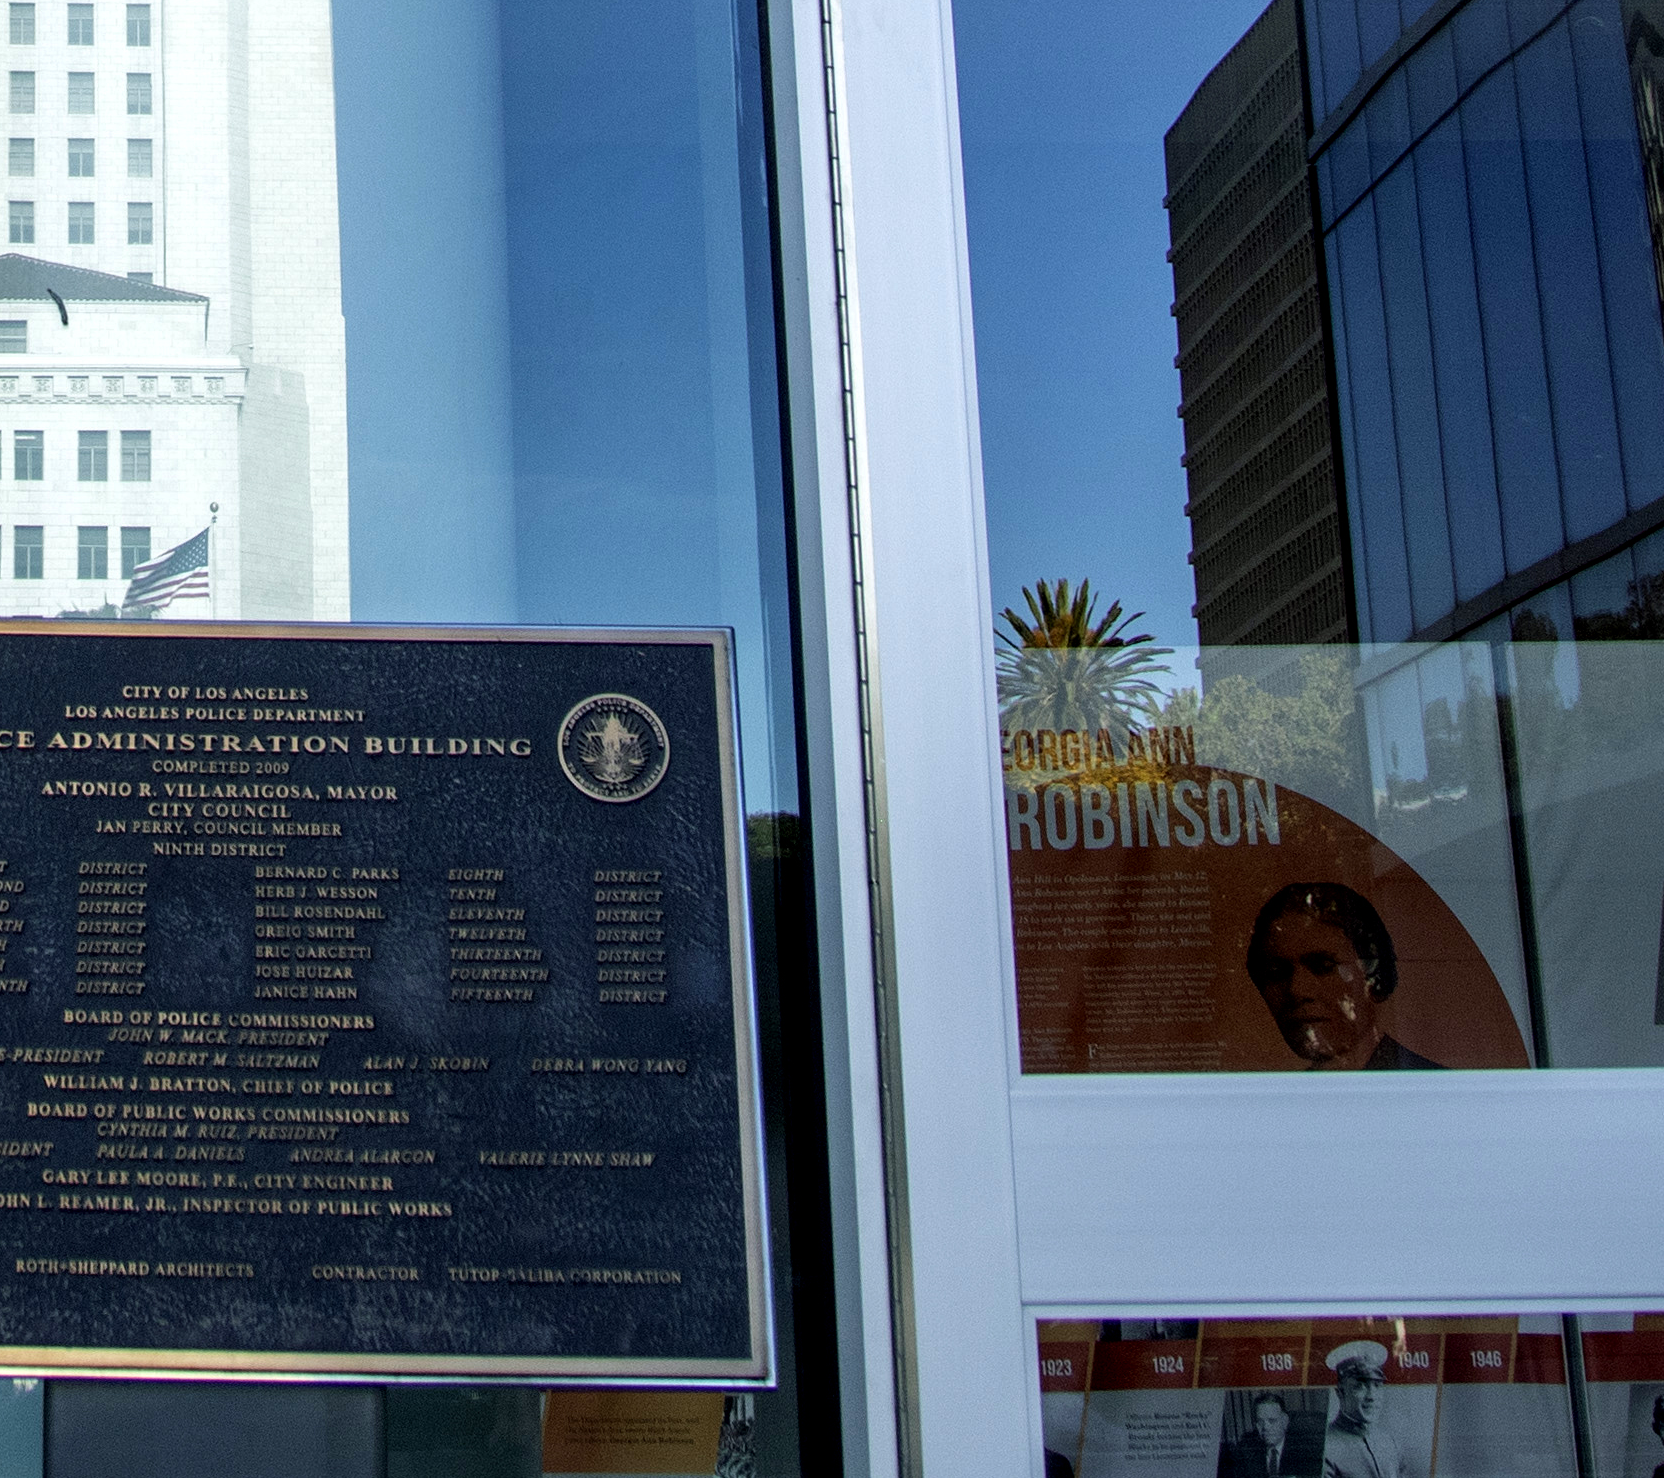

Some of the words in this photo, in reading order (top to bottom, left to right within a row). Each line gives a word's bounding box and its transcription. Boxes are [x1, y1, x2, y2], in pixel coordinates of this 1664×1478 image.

[122, 685, 163, 699] CITY
[168, 686, 191, 700] OF
[195, 687, 227, 700] LOS
[232, 687, 309, 701] ANGELES
[65, 705, 98, 719] LOS
[102, 706, 180, 720] ANGELES
[185, 707, 247, 721] POLICE
[253, 708, 367, 722] DEPARTMENT
[46, 731, 350, 755] ADMINISTRATION
[363, 736, 532, 757] BUILDING
[1001, 727, 1116, 772] EORGIA
[1127, 725, 1196, 767] ANN
[151, 760, 250, 775] COMPLETED
[255, 762, 290, 775] 2009
[41, 781, 132, 797] ANTONIO
[138, 783, 157, 798] R.
[164, 783, 320, 801] VILLARAIGOSA,
[327, 785, 399, 801] MAYOR
[147, 803, 195, 818] CITY
[202, 804, 292, 819] COUNCIL
[1007, 778, 1282, 851] ROBINSON
[96, 820, 127, 834] JAN
[133, 821, 188, 836] PERRY,
[193, 822, 267, 836] COUNCIL
[273, 823, 343, 837] MEMBER
[153, 843, 205, 856] NINTH
[212, 844, 287, 857] DISTRICT
[78, 862, 149, 876] DISTRICT
[352, 867, 400, 881] PARKS
[78, 882, 149, 896] DISTRICT
[316, 887, 379, 901] WESSON
[77, 901, 147, 916] DISTRICT
[254, 905, 289, 919] BILL
[294, 906, 387, 920] ROSENDAHL
[76, 921, 147, 936] DISTRICT
[307, 926, 356, 940] SMITH
[76, 941, 147, 956] DISTRICT
[75, 961, 146, 975] DISTRICT
[75, 981, 146, 996] DISTRICT
[63, 1009, 124, 1024] BOARD
[129, 1011, 153, 1025] OF
[157, 1012, 223, 1026] POLICE
[228, 1013, 375, 1030] COMMISSIONERS
[107, 1027, 154, 1043] JOHN
[236, 1031, 330, 1046] PRESIDENT
[143, 1050, 209, 1066] ROBERT
[43, 1075, 125, 1091] WILLIAM
[149, 1077, 237, 1094] BRATTON,
[242, 1079, 295, 1094] CHIEF
[301, 1080, 324, 1094] OF
[329, 1081, 394, 1096] POLICE
[27, 1103, 88, 1118] BOARD
[94, 1104, 118, 1118] OF
[122, 1105, 187, 1120] PUBLIC
[193, 1106, 256, 1121] WORKS
[262, 1107, 410, 1124] COMMISSIONERS
[42, 1169, 92, 1184] GARY
[96, 1170, 131, 1185] LEE
[254, 1174, 296, 1189] CITY
[302, 1175, 394, 1192] ENGINEER
[58, 1195, 140, 1213] REAMER,
[182, 1197, 283, 1214] INSPECTOR
[288, 1200, 311, 1214] OF
[316, 1200, 382, 1216] PUBLIC
[387, 1201, 453, 1217] WORKS
[154, 1262, 255, 1278] ARCHITECTS
[311, 1265, 421, 1282] CONTRACTOR
[1041, 1359, 1073, 1377] 1923
[1152, 1356, 1185, 1374] 1924
[1260, 1354, 1292, 1372] 1936
[1397, 1351, 1429, 1368] 1940
[1470, 1350, 1502, 1368] 1946
